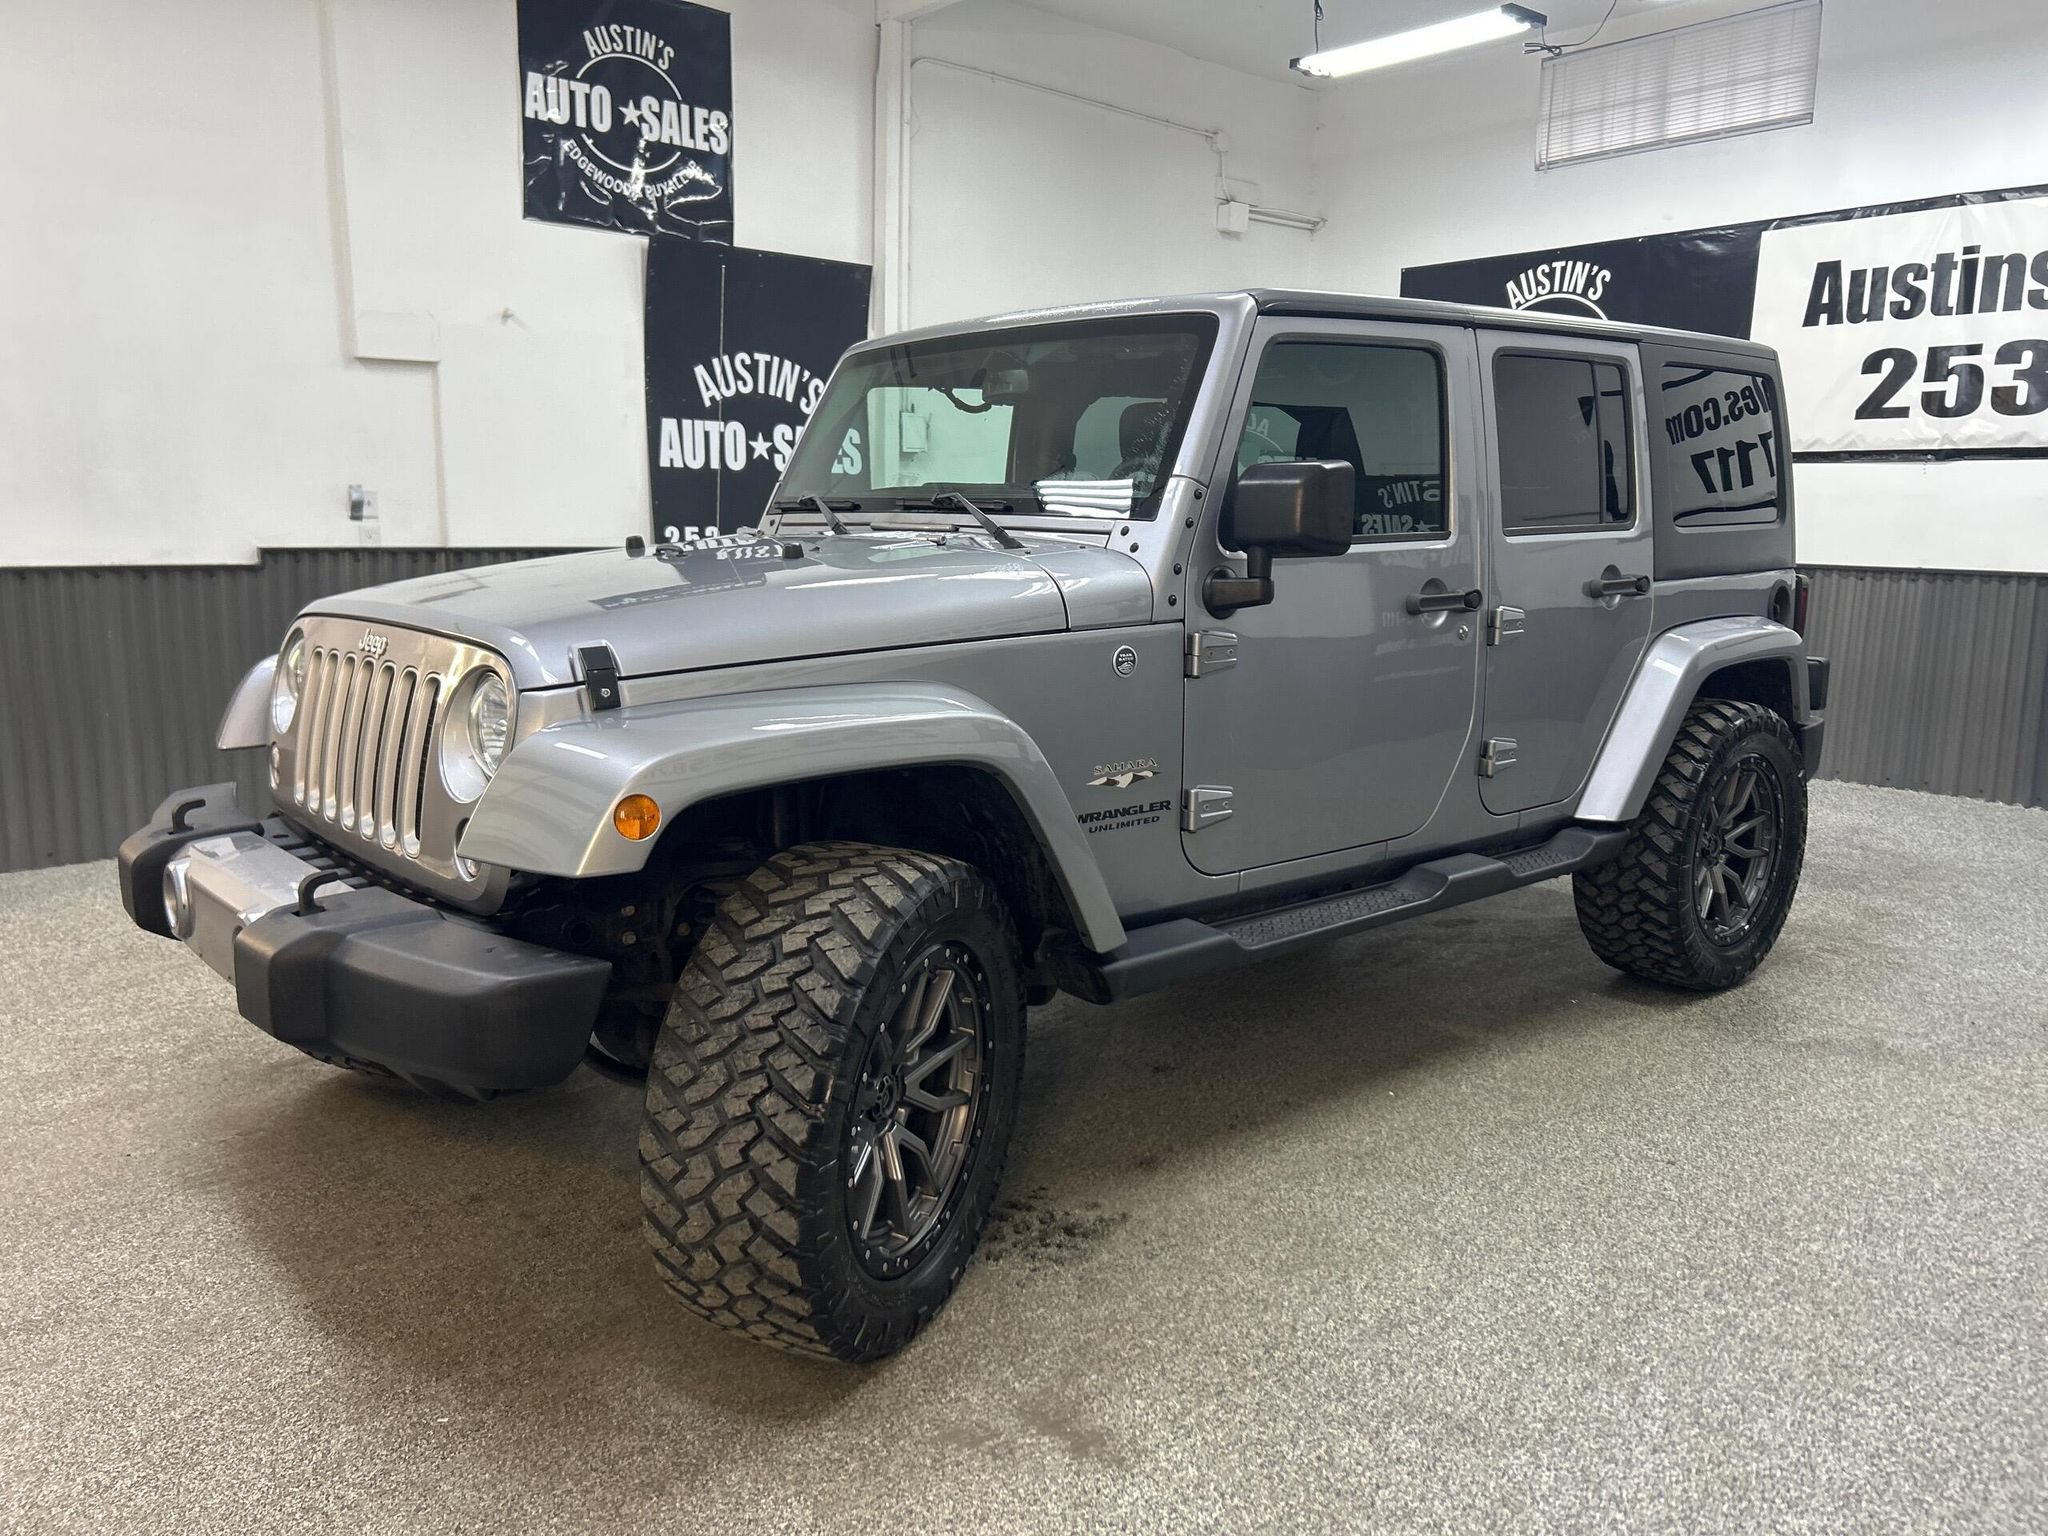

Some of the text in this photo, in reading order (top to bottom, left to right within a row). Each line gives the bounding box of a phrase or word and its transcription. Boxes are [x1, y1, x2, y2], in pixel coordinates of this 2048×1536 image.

[583, 24, 674, 70] AUSTIN'S
[525, 72, 728, 154] AUTO SALES
[563, 139, 631, 196] EDGEWOOD
[1505, 260, 1611, 309] AUSTIN'S
[693, 352, 826, 414] AUSTIN'S
[1854, 339, 2048, 420] 253
[659, 417, 747, 471] AUTO
[359, 628, 389, 660] Jeep
[1093, 758, 1158, 776] SAHARA
[1077, 800, 1172, 825] WRANGLER
[1088, 815, 1160, 834] UNLIMITED
